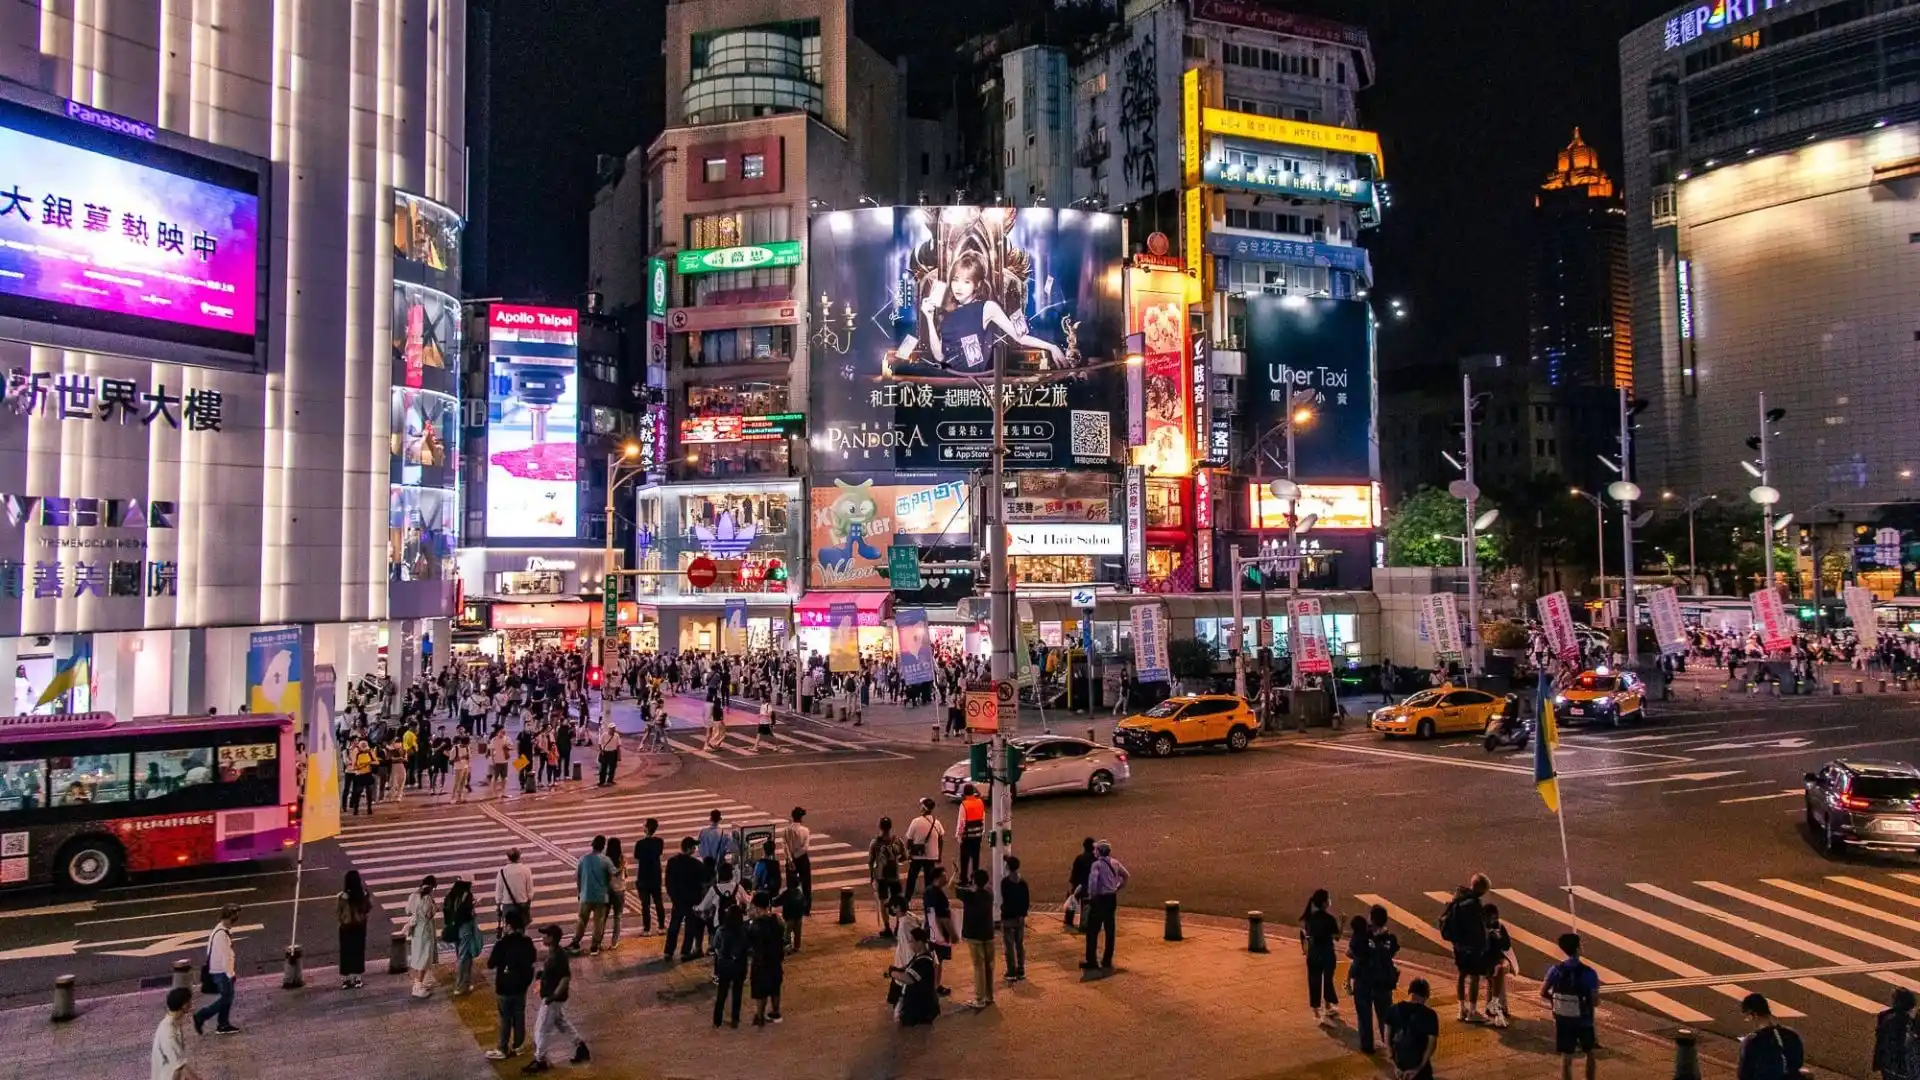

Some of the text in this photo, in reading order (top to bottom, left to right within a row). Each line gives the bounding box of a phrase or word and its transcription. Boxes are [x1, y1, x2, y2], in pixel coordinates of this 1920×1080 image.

[68, 101, 156, 140] Panasonic
[1293, 178, 1322, 192] HOTEL
[0, 185, 217, 261] 大銀幕熱映中
[496, 311, 573, 327] Apollo Taipei
[1269, 363, 1348, 387] Uber Taxi
[7, 368, 223, 433] 新世界大樓
[1270, 388, 1348, 405] 優小黃
[827, 424, 929, 451] PANDORA
[956, 450, 990, 459] App Store
[1014, 450, 1048, 460] Google play
[896, 479, 965, 515] 西門町
[1044, 533, 1073, 545] Hair
[1077, 534, 1110, 545] Salon
[810, 557, 881, 588] Welcom
[221, 746, 275, 761] 欣欣客運
